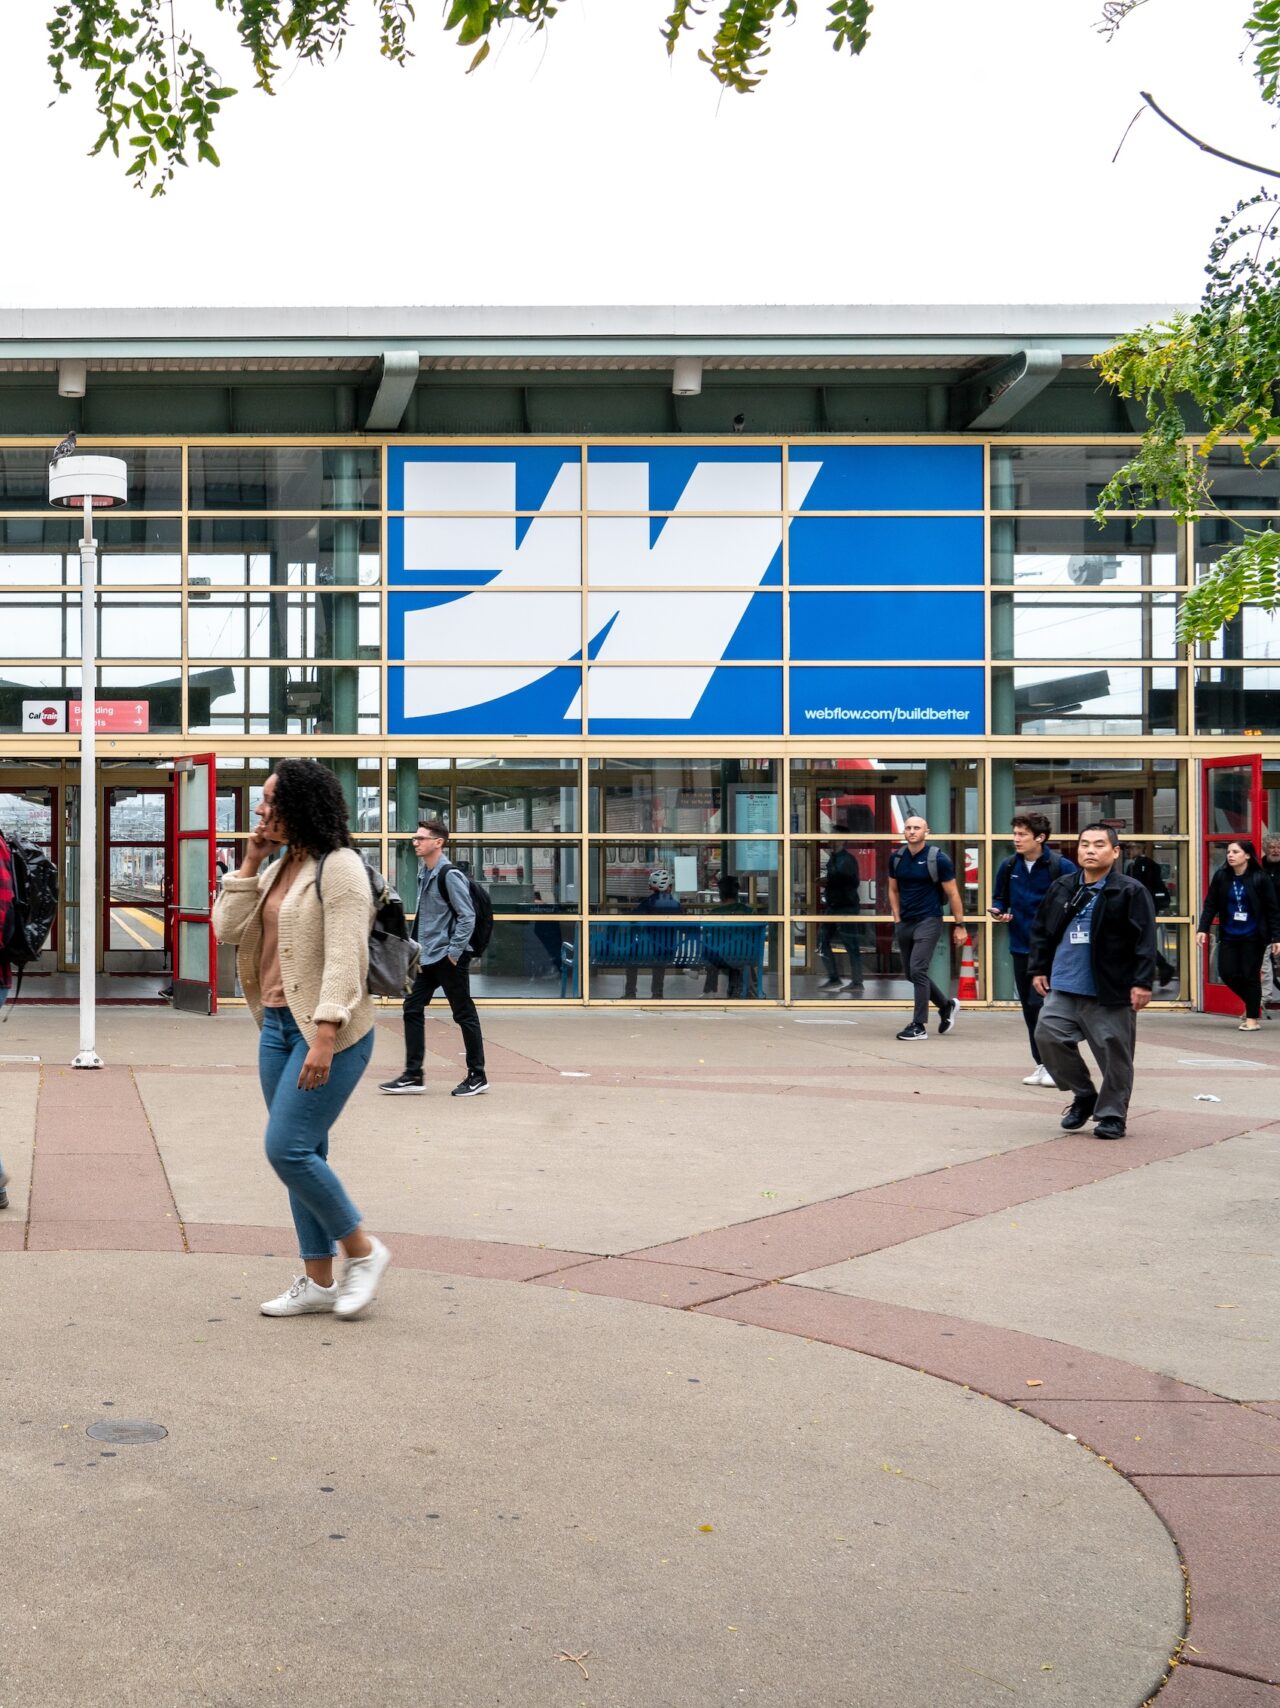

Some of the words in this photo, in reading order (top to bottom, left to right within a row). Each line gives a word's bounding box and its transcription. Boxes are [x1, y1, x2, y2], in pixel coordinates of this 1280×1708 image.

[74, 706, 113, 715] Bding
[804, 706, 971, 722] webflow.com/buildbetter
[28, 712, 58, 720] Caltrain
